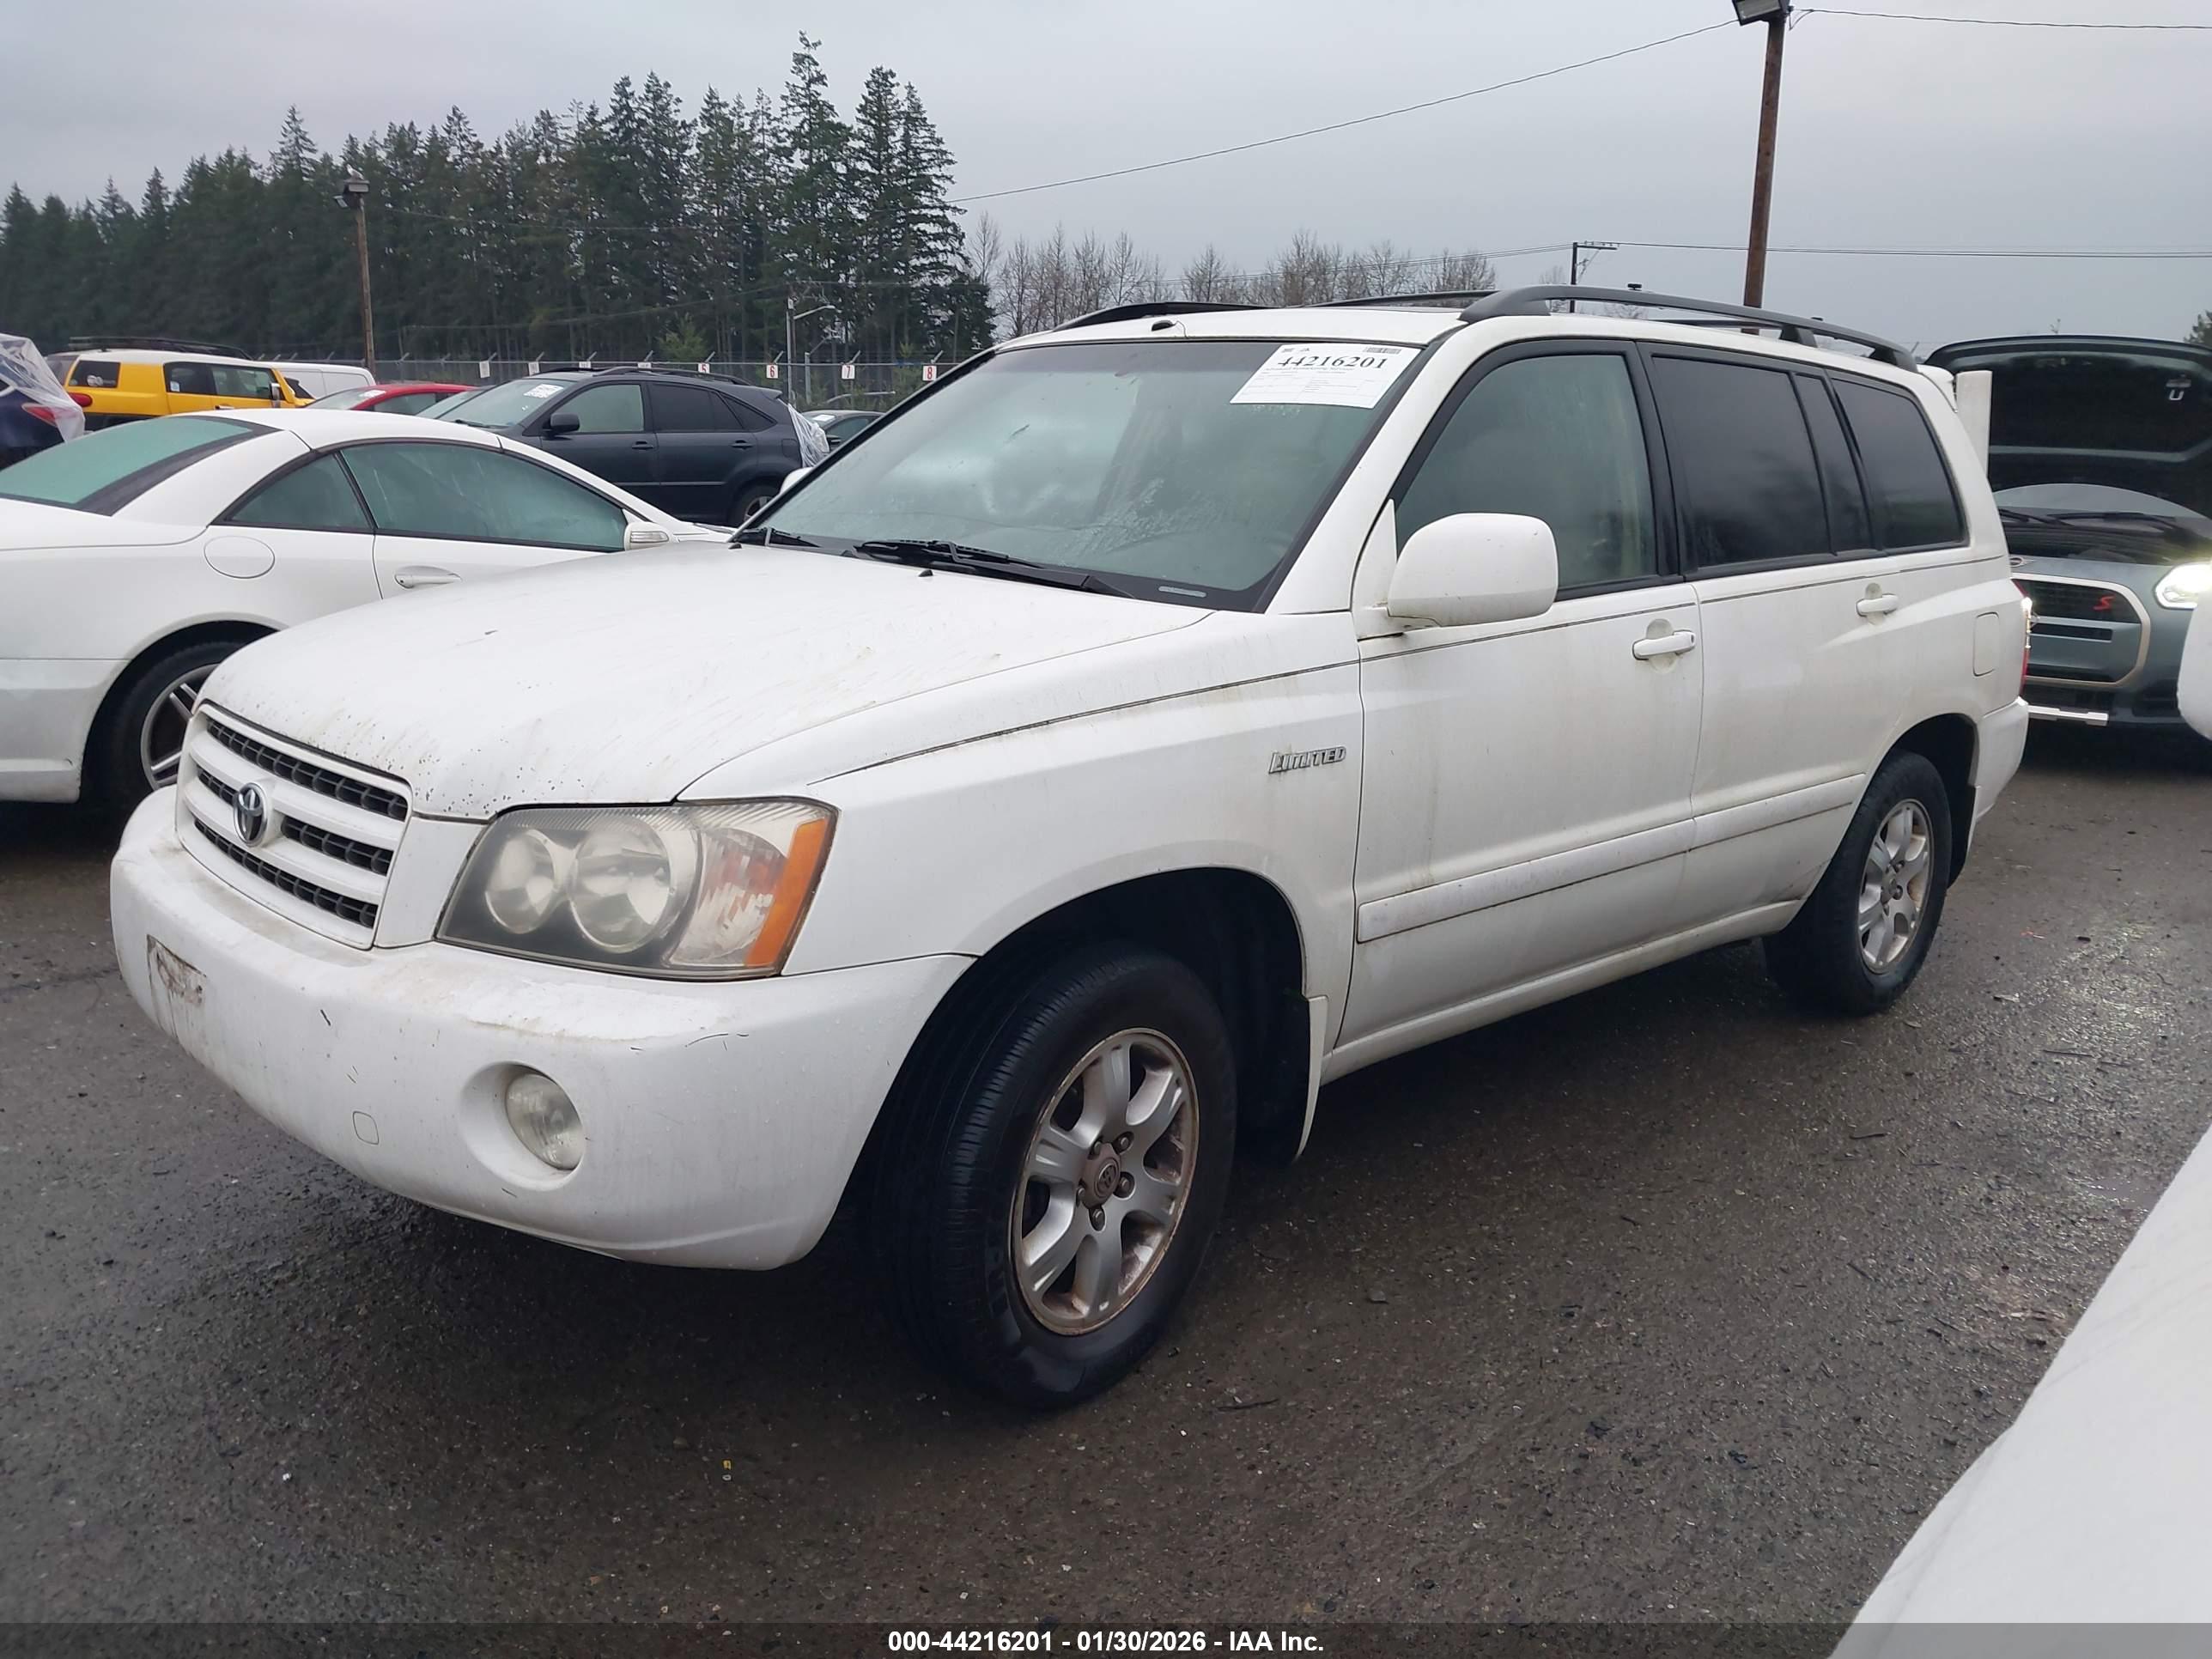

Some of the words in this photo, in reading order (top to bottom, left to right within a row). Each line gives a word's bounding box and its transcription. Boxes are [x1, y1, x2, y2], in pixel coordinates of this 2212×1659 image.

[1278, 356, 1388, 368] 44216201
[2093, 594, 2116, 611] S
[1268, 746, 1346, 775] LIMITED
